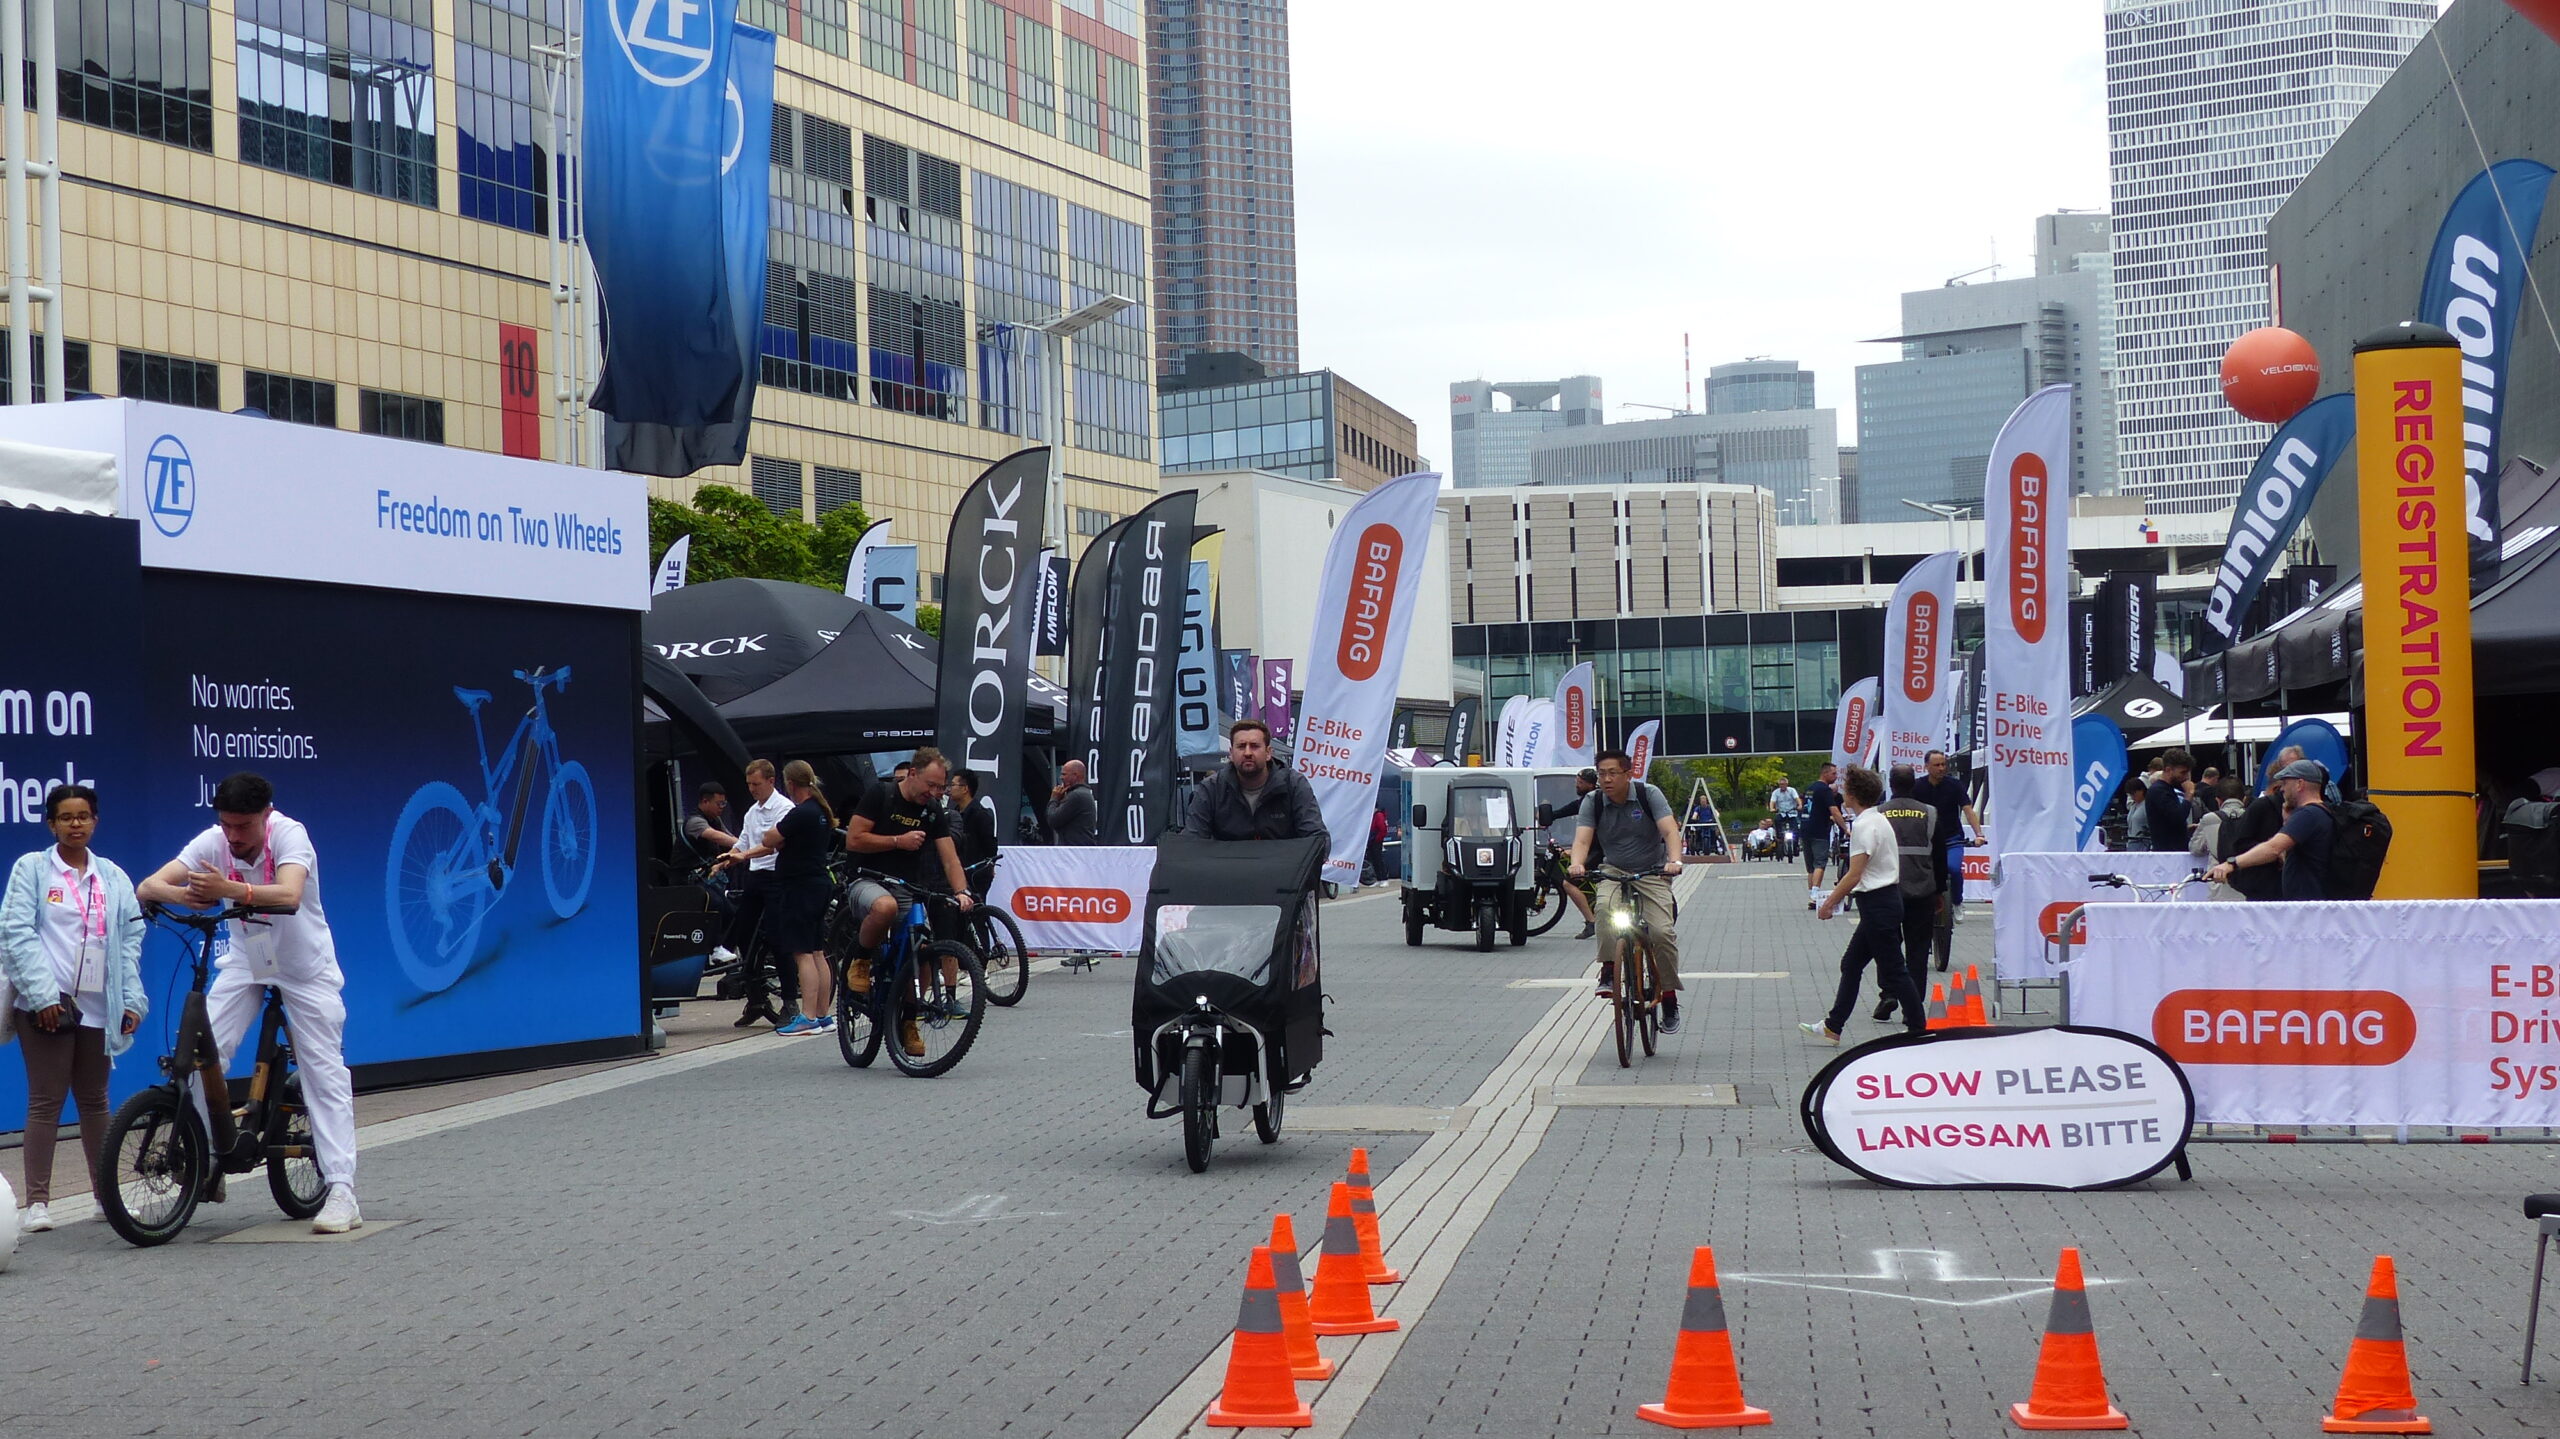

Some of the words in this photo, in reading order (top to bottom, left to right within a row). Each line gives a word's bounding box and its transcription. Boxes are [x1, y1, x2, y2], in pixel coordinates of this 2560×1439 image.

[2124, 8, 2154, 26] ONE
[504, 339, 535, 398] 10
[149, 450, 194, 522] ZF
[377, 489, 470, 539] Freedom
[477, 510, 503, 542] on
[508, 506, 549, 549] Two
[554, 511, 623, 555] Wheels
[2165, 533, 2209, 544] messe
[2021, 475, 2040, 621] BAFANG
[2393, 380, 2443, 757] REGISTRATION
[1047, 566, 1058, 646] AMFLOW
[1349, 541, 1391, 663] BAFANG
[1911, 604, 1931, 690] BAFANG
[2129, 583, 2140, 673] MERIDA
[2085, 613, 2093, 693] CENTURION
[192, 673, 218, 709] No
[224, 677, 295, 711] worries.
[1995, 692, 2048, 716] E-Bike
[46, 690, 92, 736] on
[1305, 716, 1363, 741] E-Bike
[1570, 693, 1579, 743] BAFANG
[1847, 703, 1861, 748] BAFANG
[1994, 718, 2043, 740] Drive
[193, 723, 220, 758] No
[225, 726, 318, 759] emissions.
[1302, 736, 1350, 760] Drive
[1891, 731, 1930, 745] E-Bike
[1891, 745, 1924, 759] Drive
[1994, 742, 2068, 768] Systems
[1297, 758, 1373, 785] Systems
[1024, 895, 1118, 914] BAFANG
[2184, 1009, 2384, 1046] BAFANG
[1856, 1070, 1982, 1100] SLOW
[1995, 1062, 2146, 1096] PLEASE
[2489, 1056, 2560, 1100] Sys
[1856, 1123, 2051, 1152] LANGSAM
[2061, 1117, 2161, 1148] BITTE
